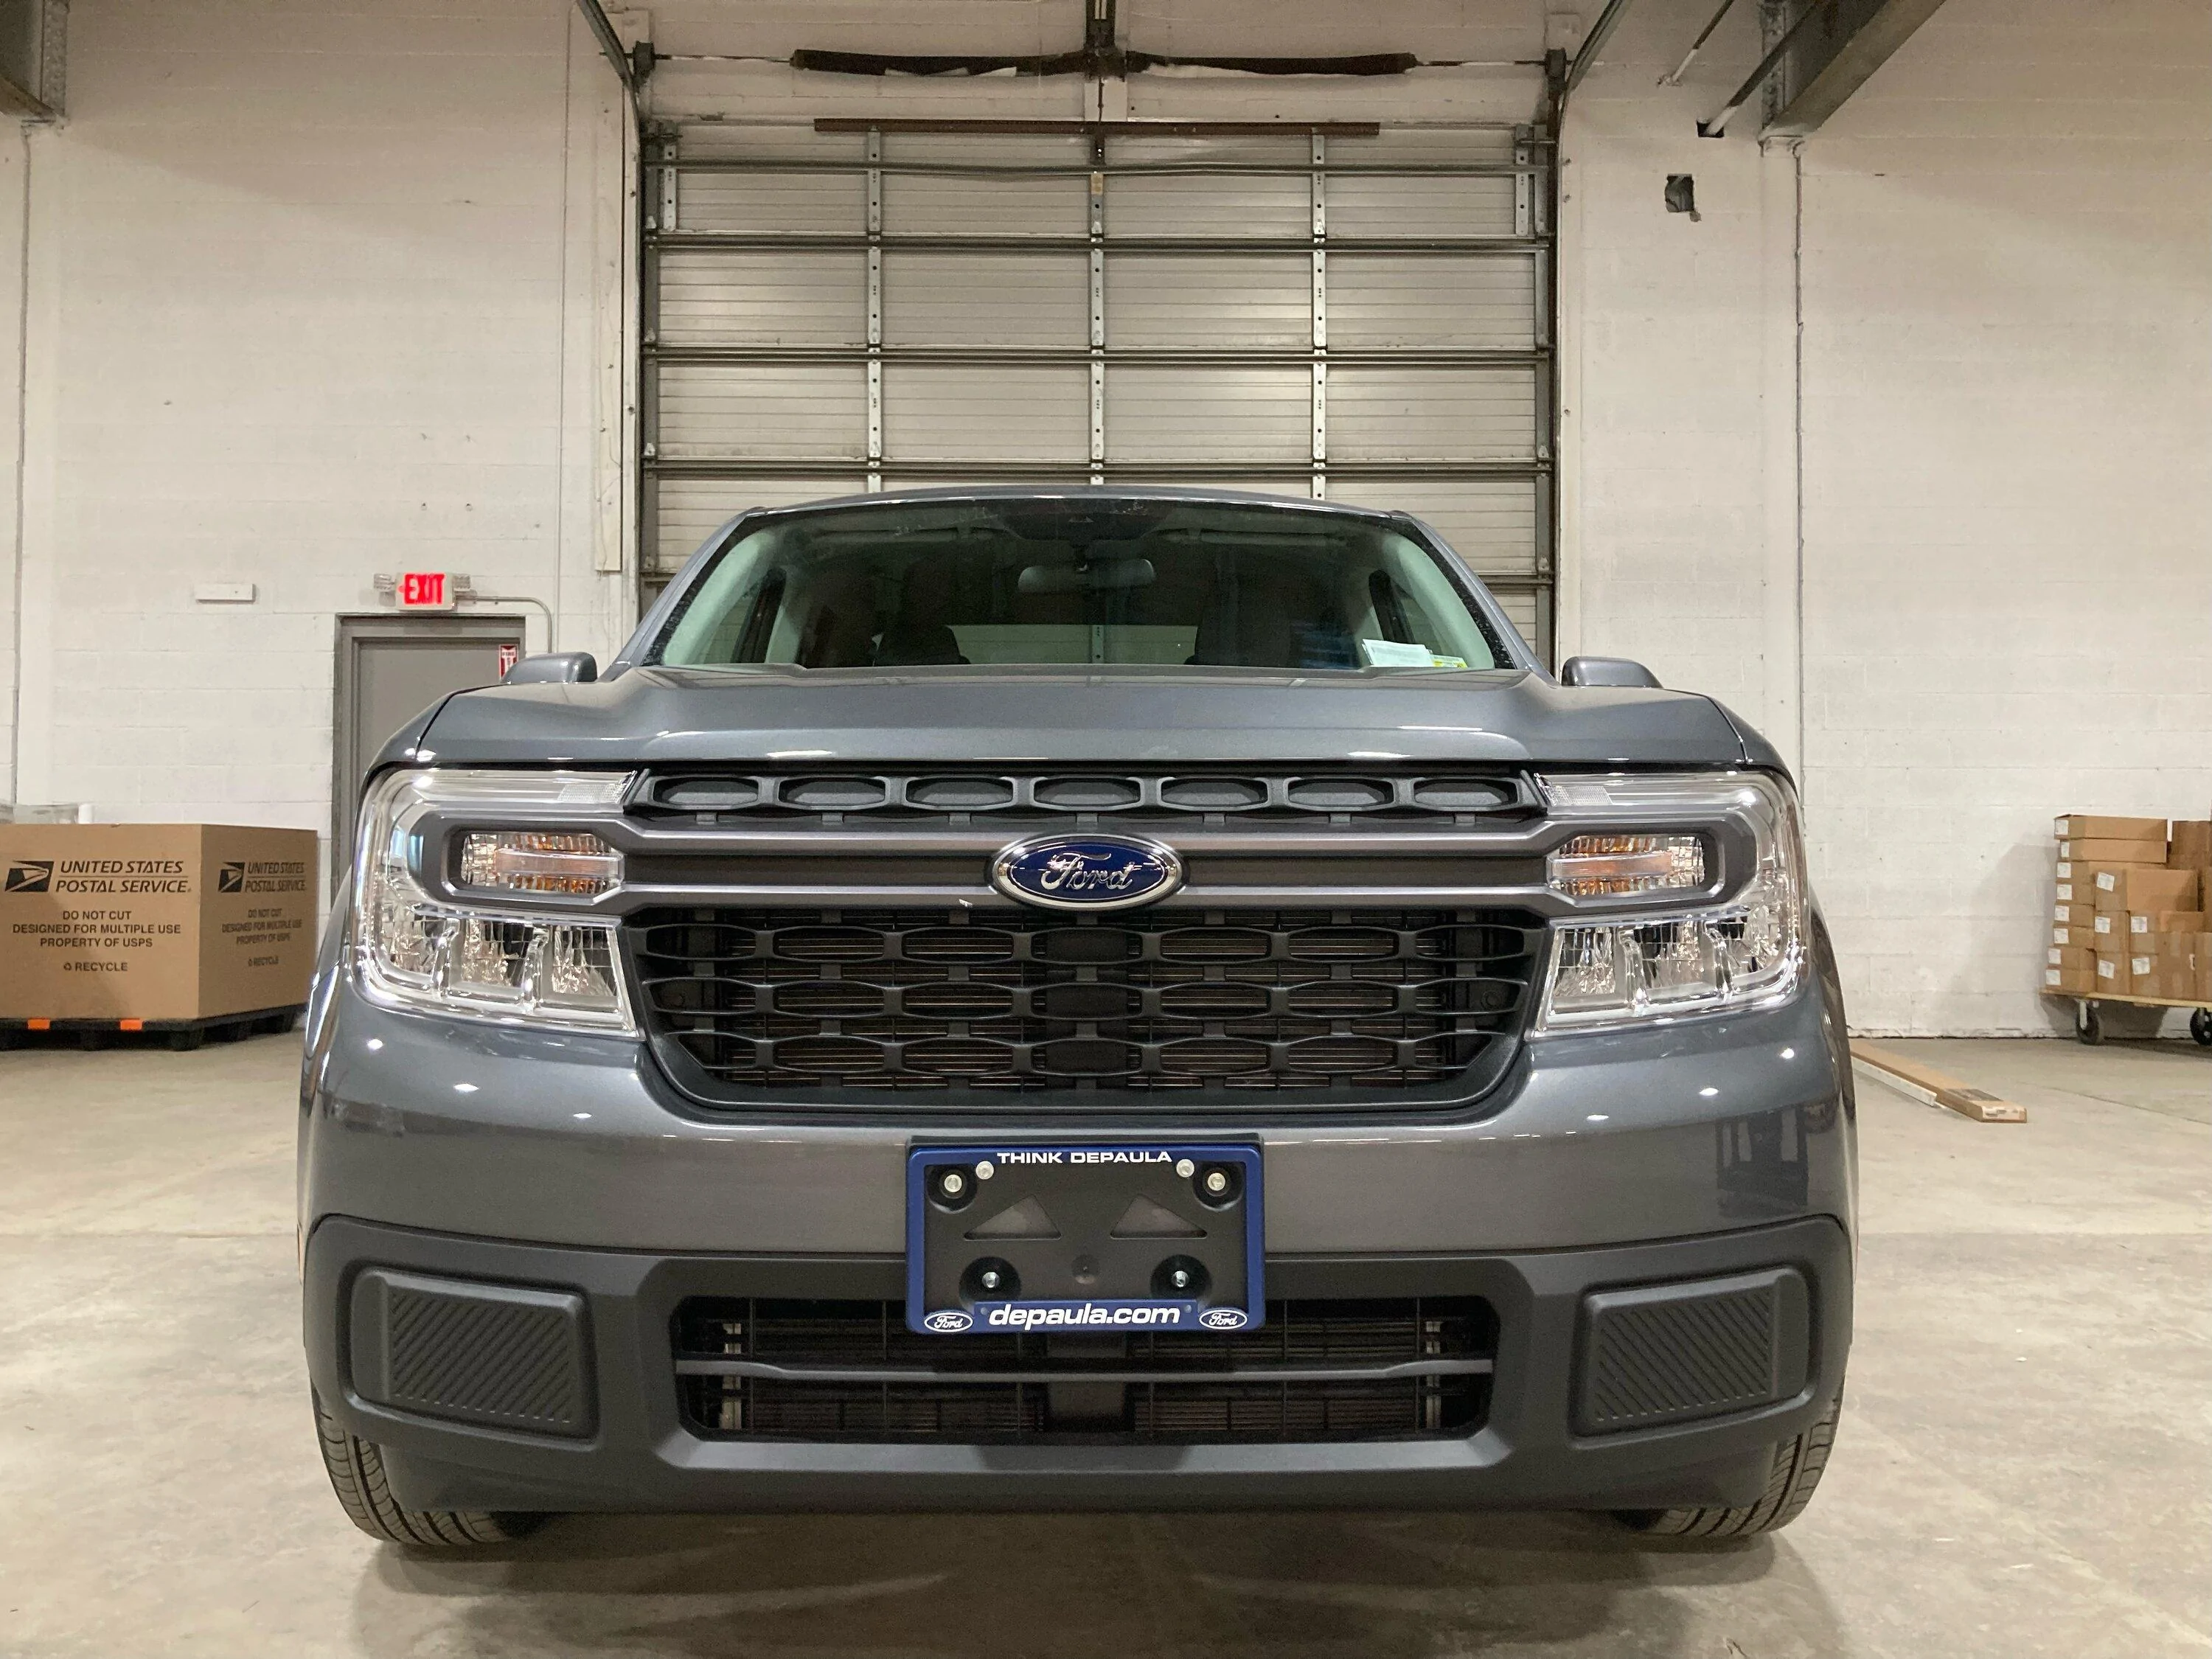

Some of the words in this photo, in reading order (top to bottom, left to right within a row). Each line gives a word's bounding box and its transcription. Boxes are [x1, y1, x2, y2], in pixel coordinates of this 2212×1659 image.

[405, 573, 445, 605] EXIT
[60, 860, 123, 874] UNITED
[125, 860, 184, 874] STATES
[248, 862, 279, 874] UNITED
[281, 862, 305, 874] STATES
[1040, 850, 1133, 890] Ford
[55, 880, 116, 893] POSTAL
[245, 880, 276, 892] POSTAL
[63, 911, 79, 920] DO
[83, 911, 105, 920] NOT
[109, 911, 131, 919] CUT
[13, 924, 70, 933] DESIGNED
[74, 924, 97, 933] FOR
[101, 924, 155, 933] MULTIPLE
[158, 924, 181, 933] USE
[40, 938, 100, 947] PROPERTY
[104, 938, 119, 947] OF
[123, 938, 153, 947] USPS
[75, 962, 128, 972] RECYCLE
[997, 1152, 1062, 1164] THINK
[1070, 1151, 1172, 1164] DEPAULA
[933, 1315, 964, 1329] Ford
[989, 1303, 1180, 1331] depaula.com
[1208, 1312, 1238, 1326] Ford
